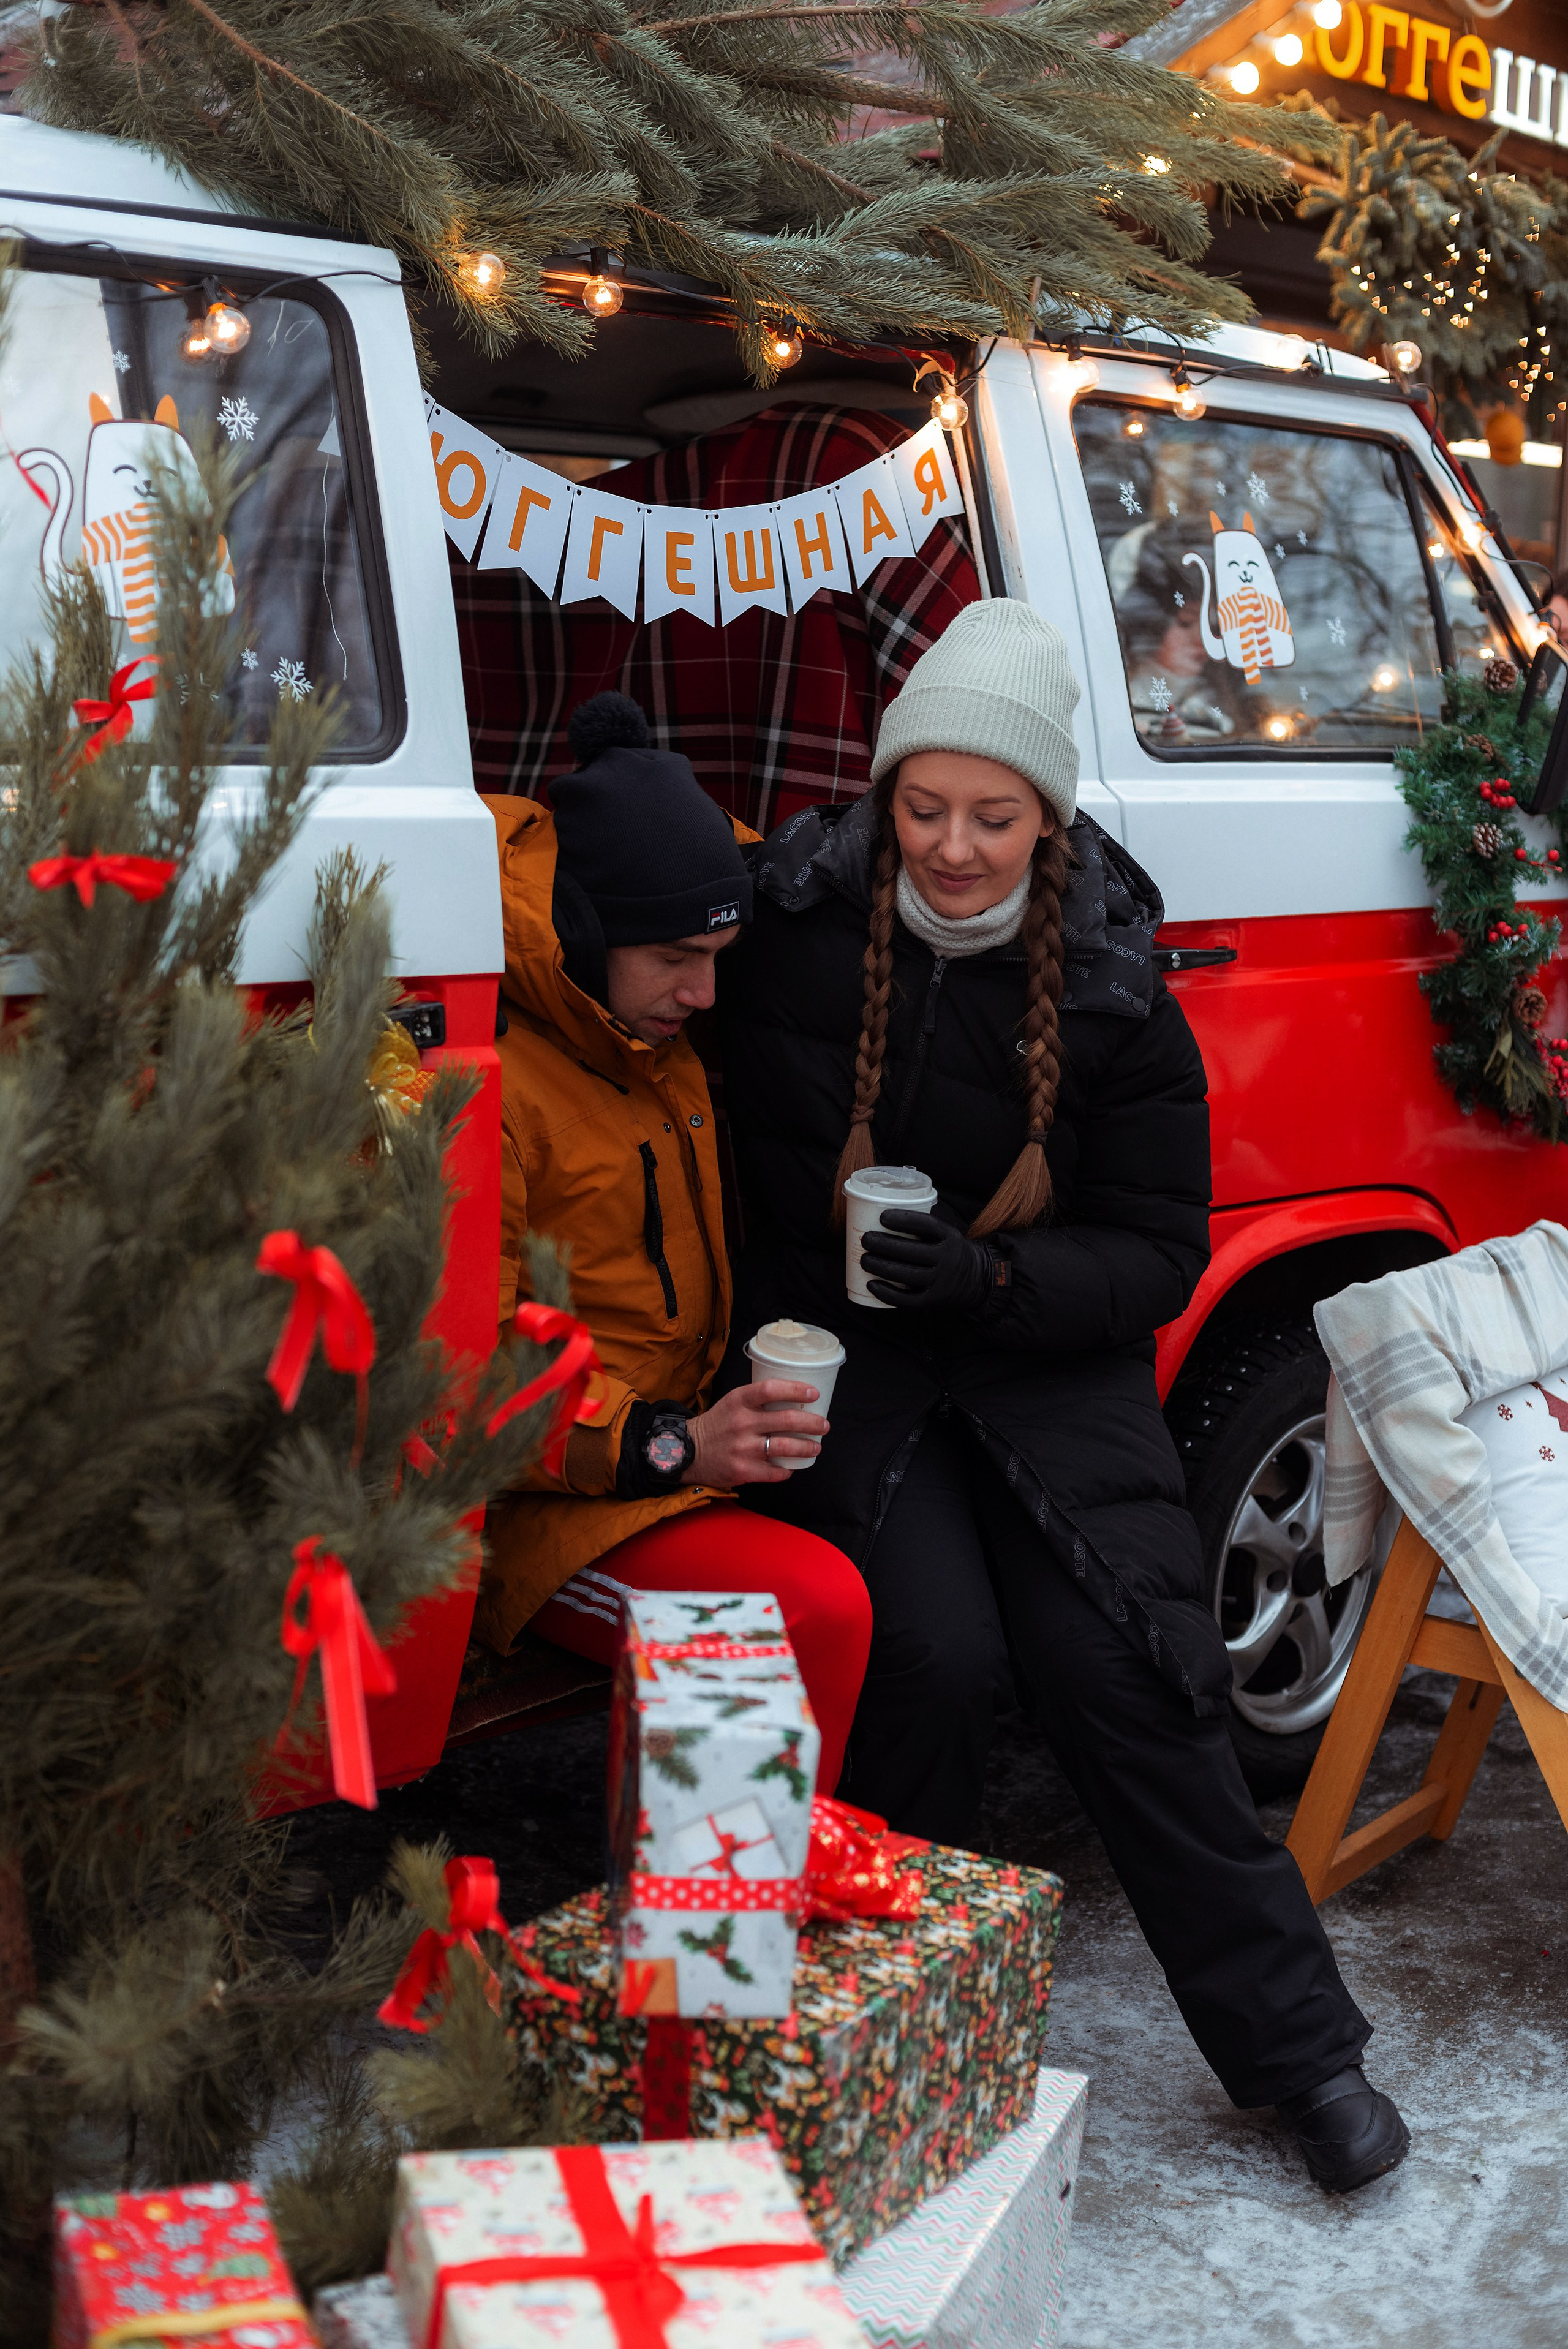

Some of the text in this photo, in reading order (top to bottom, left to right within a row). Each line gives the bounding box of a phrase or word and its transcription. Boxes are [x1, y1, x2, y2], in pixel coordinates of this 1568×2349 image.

[710, 908, 737, 926] FILA
[1106, 940, 1146, 965] LACOS
[1074, 1534, 1086, 1577] COSTE
